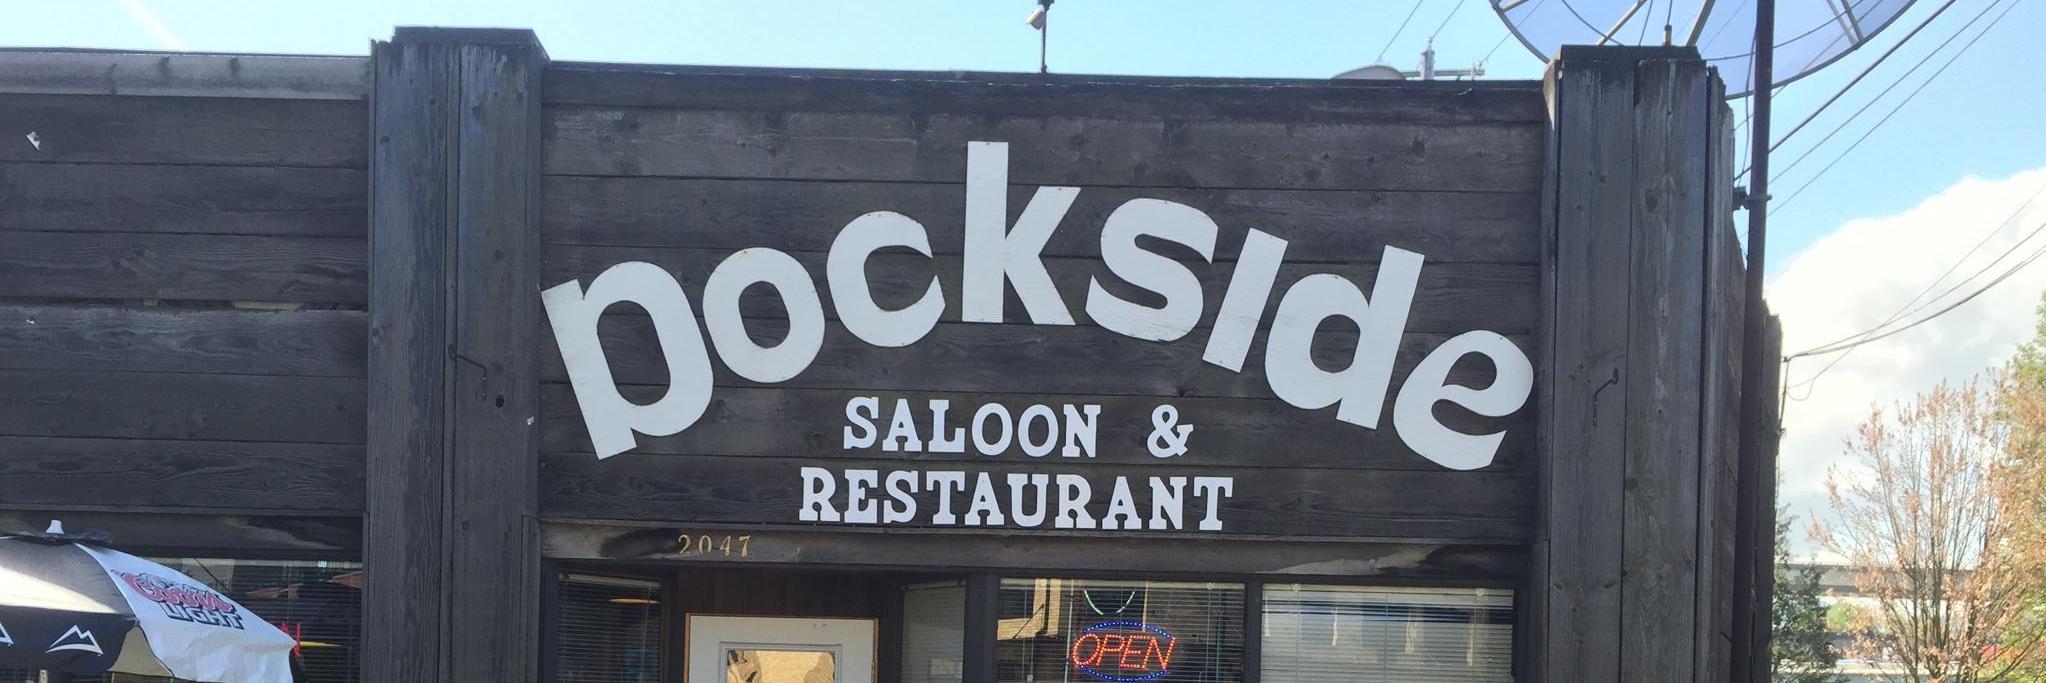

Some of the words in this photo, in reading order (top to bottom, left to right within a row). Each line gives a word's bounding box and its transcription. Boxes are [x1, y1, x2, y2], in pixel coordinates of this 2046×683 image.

[843, 396, 1101, 458] SALOON
[1147, 404, 1194, 458] &
[799, 466, 1234, 531] RESTAURANT
[677, 534, 752, 558] 2047
[1071, 632, 1177, 671] OPEN
